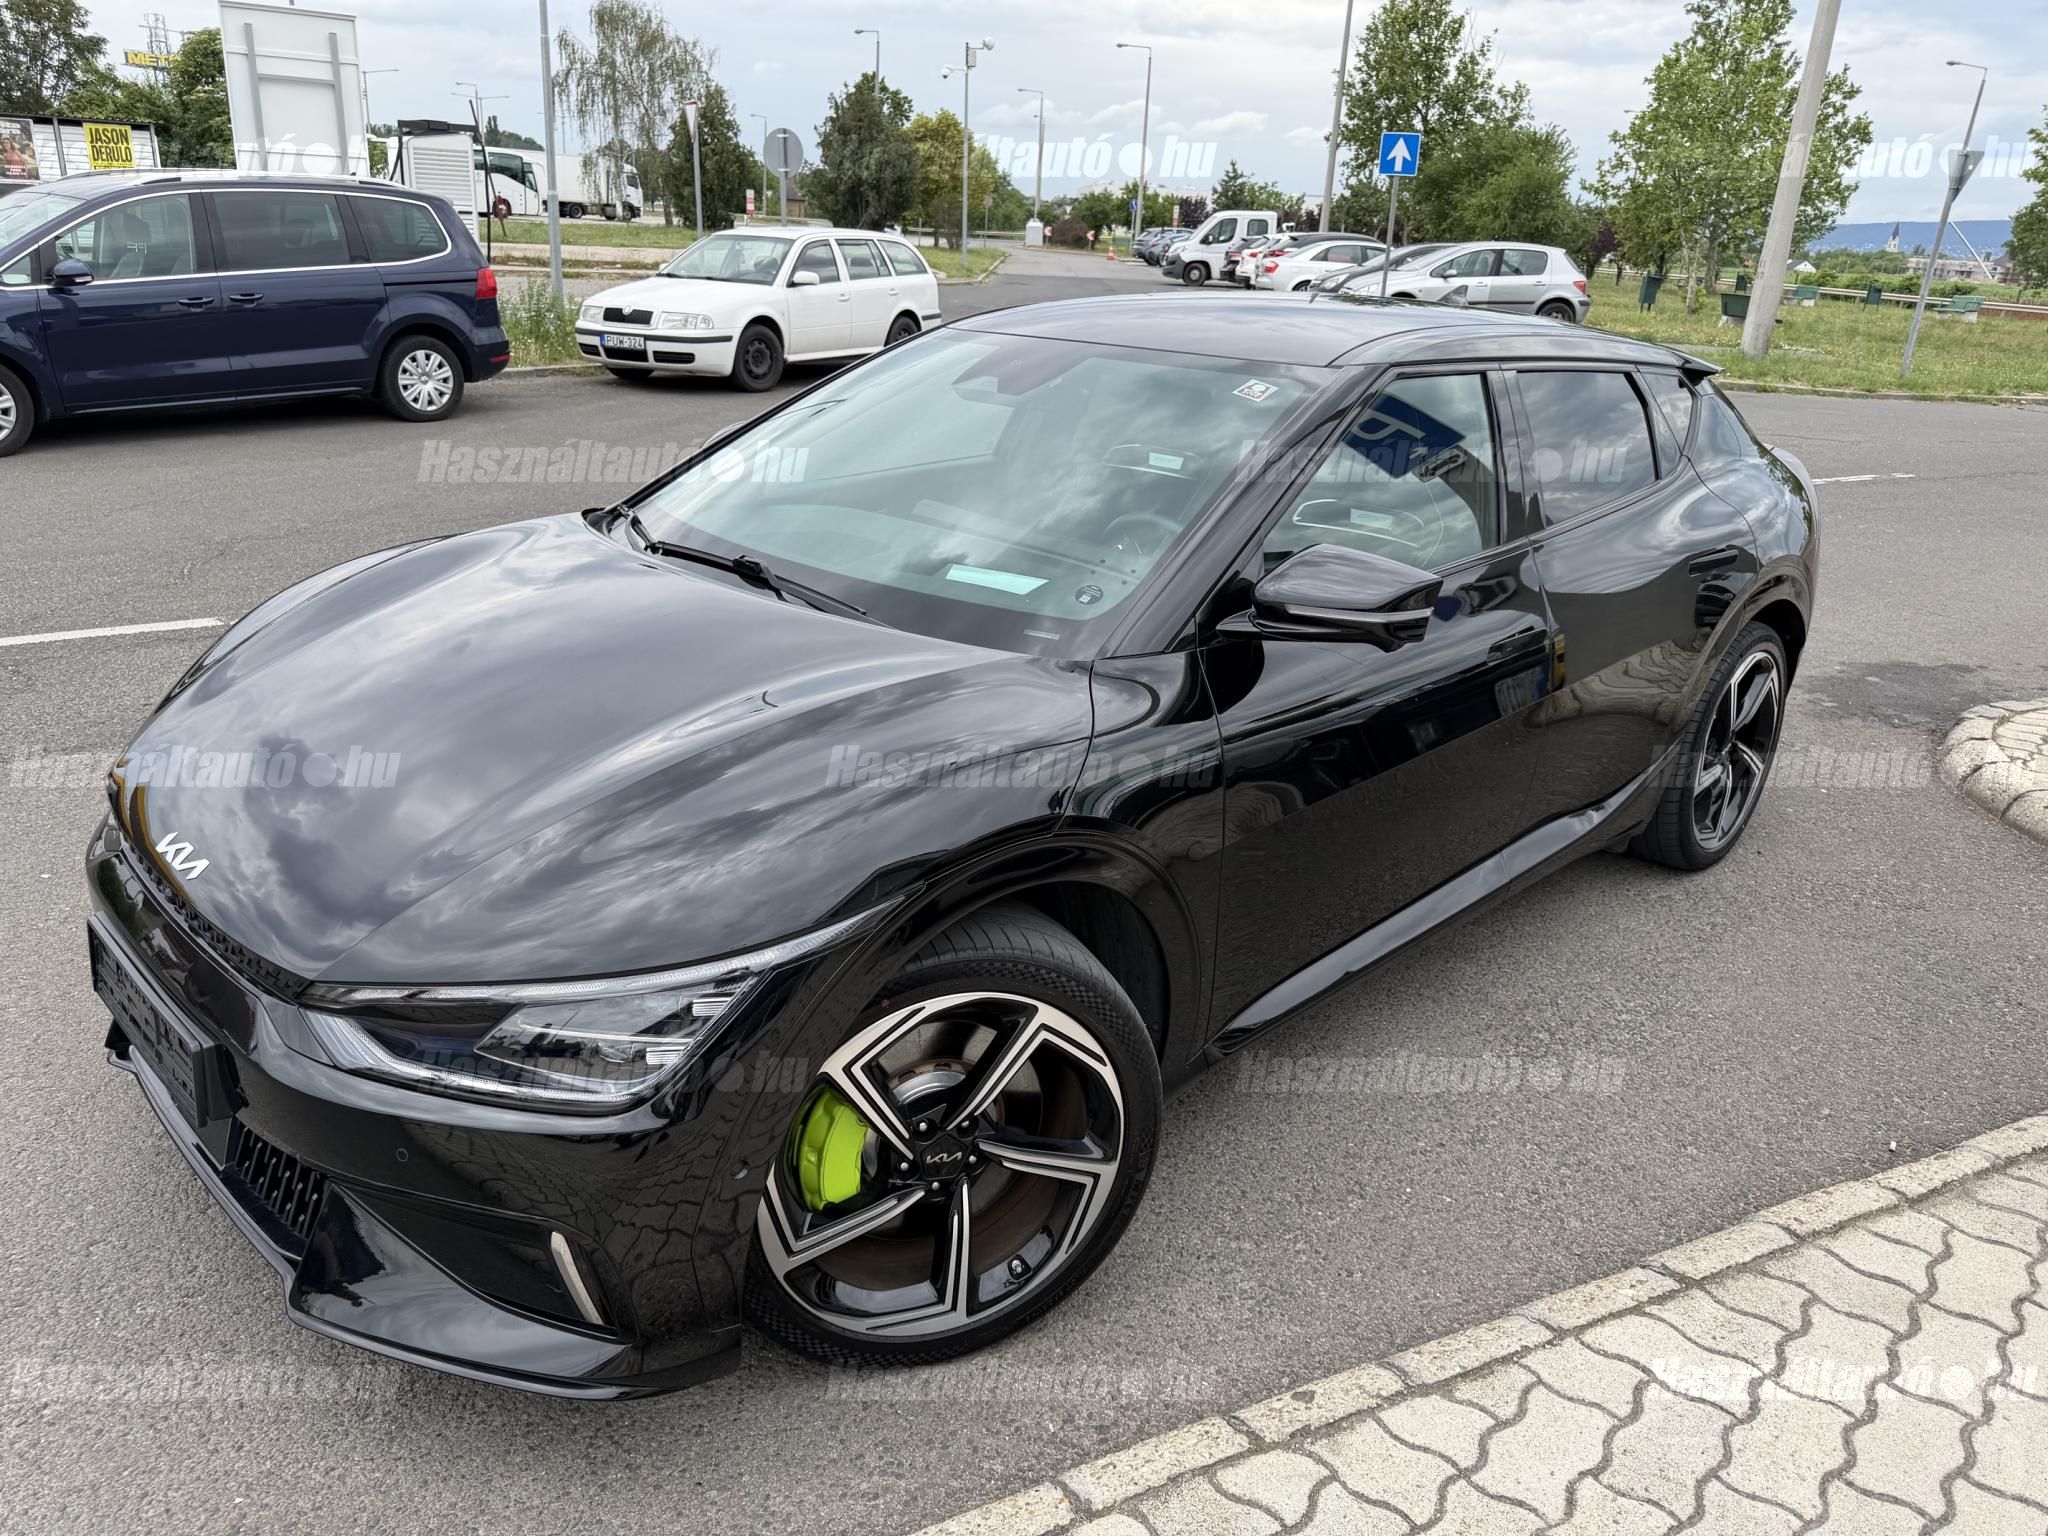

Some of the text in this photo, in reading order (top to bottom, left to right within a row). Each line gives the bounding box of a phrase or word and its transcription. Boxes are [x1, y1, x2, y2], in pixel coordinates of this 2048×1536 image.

[89, 127, 130, 146] JASON
[90, 144, 133, 163] DERULO
[606, 335, 644, 349] PUW-324
